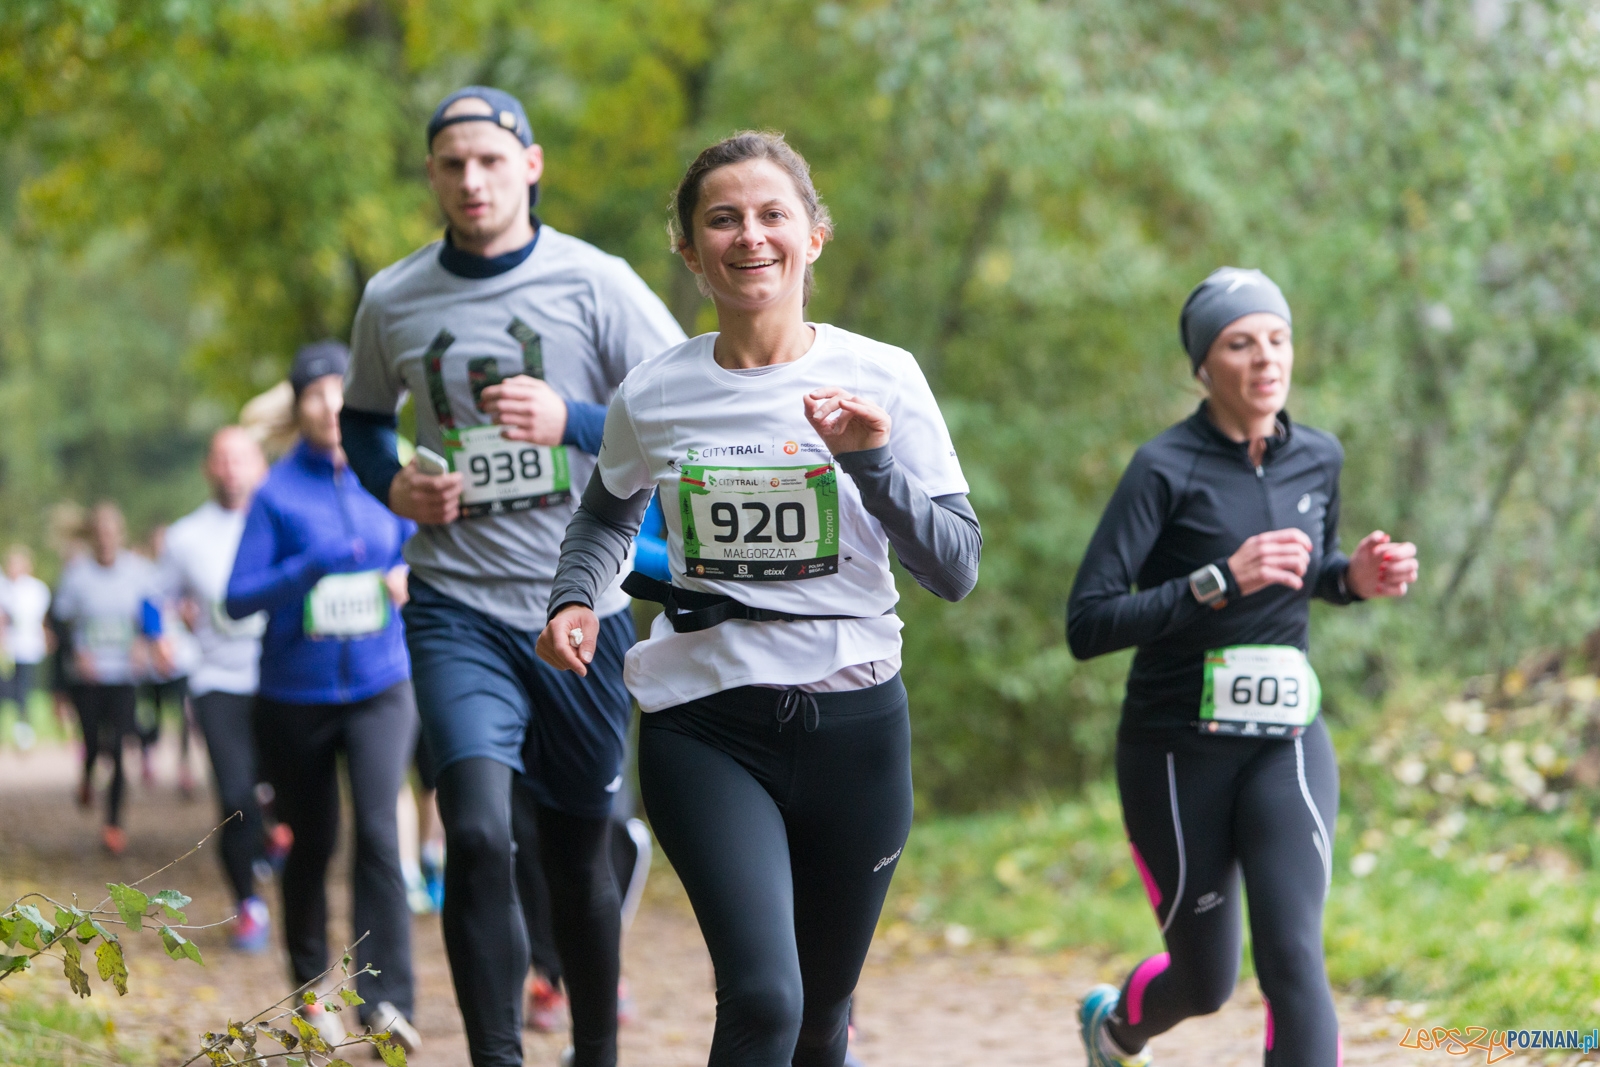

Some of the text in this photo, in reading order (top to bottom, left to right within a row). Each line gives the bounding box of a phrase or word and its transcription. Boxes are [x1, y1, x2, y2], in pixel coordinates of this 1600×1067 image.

[470, 448, 541, 487] 938
[711, 502, 806, 543] 920
[824, 508, 833, 545] Poznań
[723, 548, 797, 559] MAŁGORZATA
[1231, 676, 1299, 707] 603
